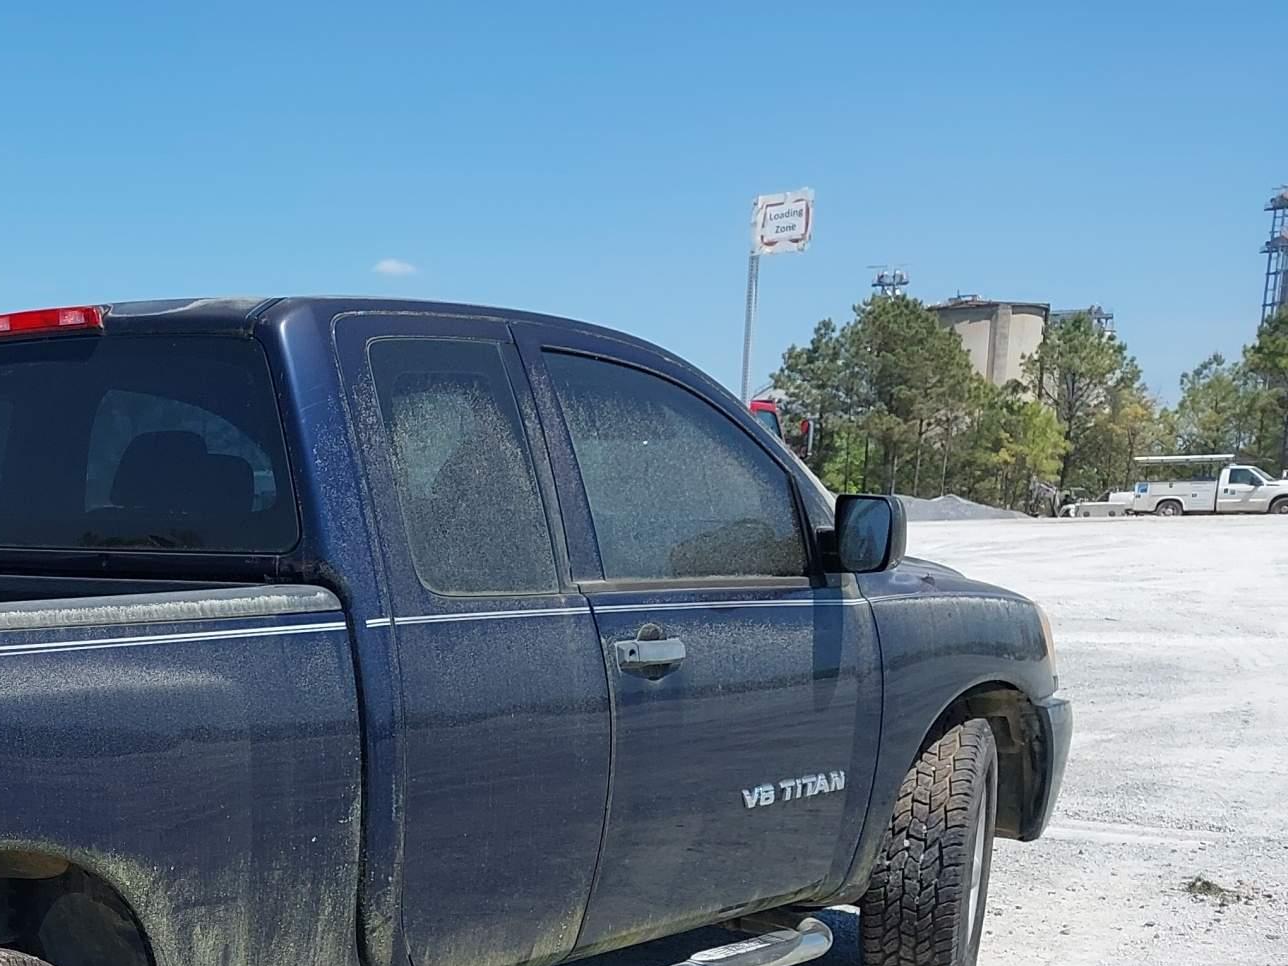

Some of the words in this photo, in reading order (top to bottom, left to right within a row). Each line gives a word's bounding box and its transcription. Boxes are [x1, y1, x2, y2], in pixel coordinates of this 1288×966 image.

[769, 208, 803, 221] Loading
[775, 224, 796, 234] Zone
[778, 770, 845, 801] TITAN
